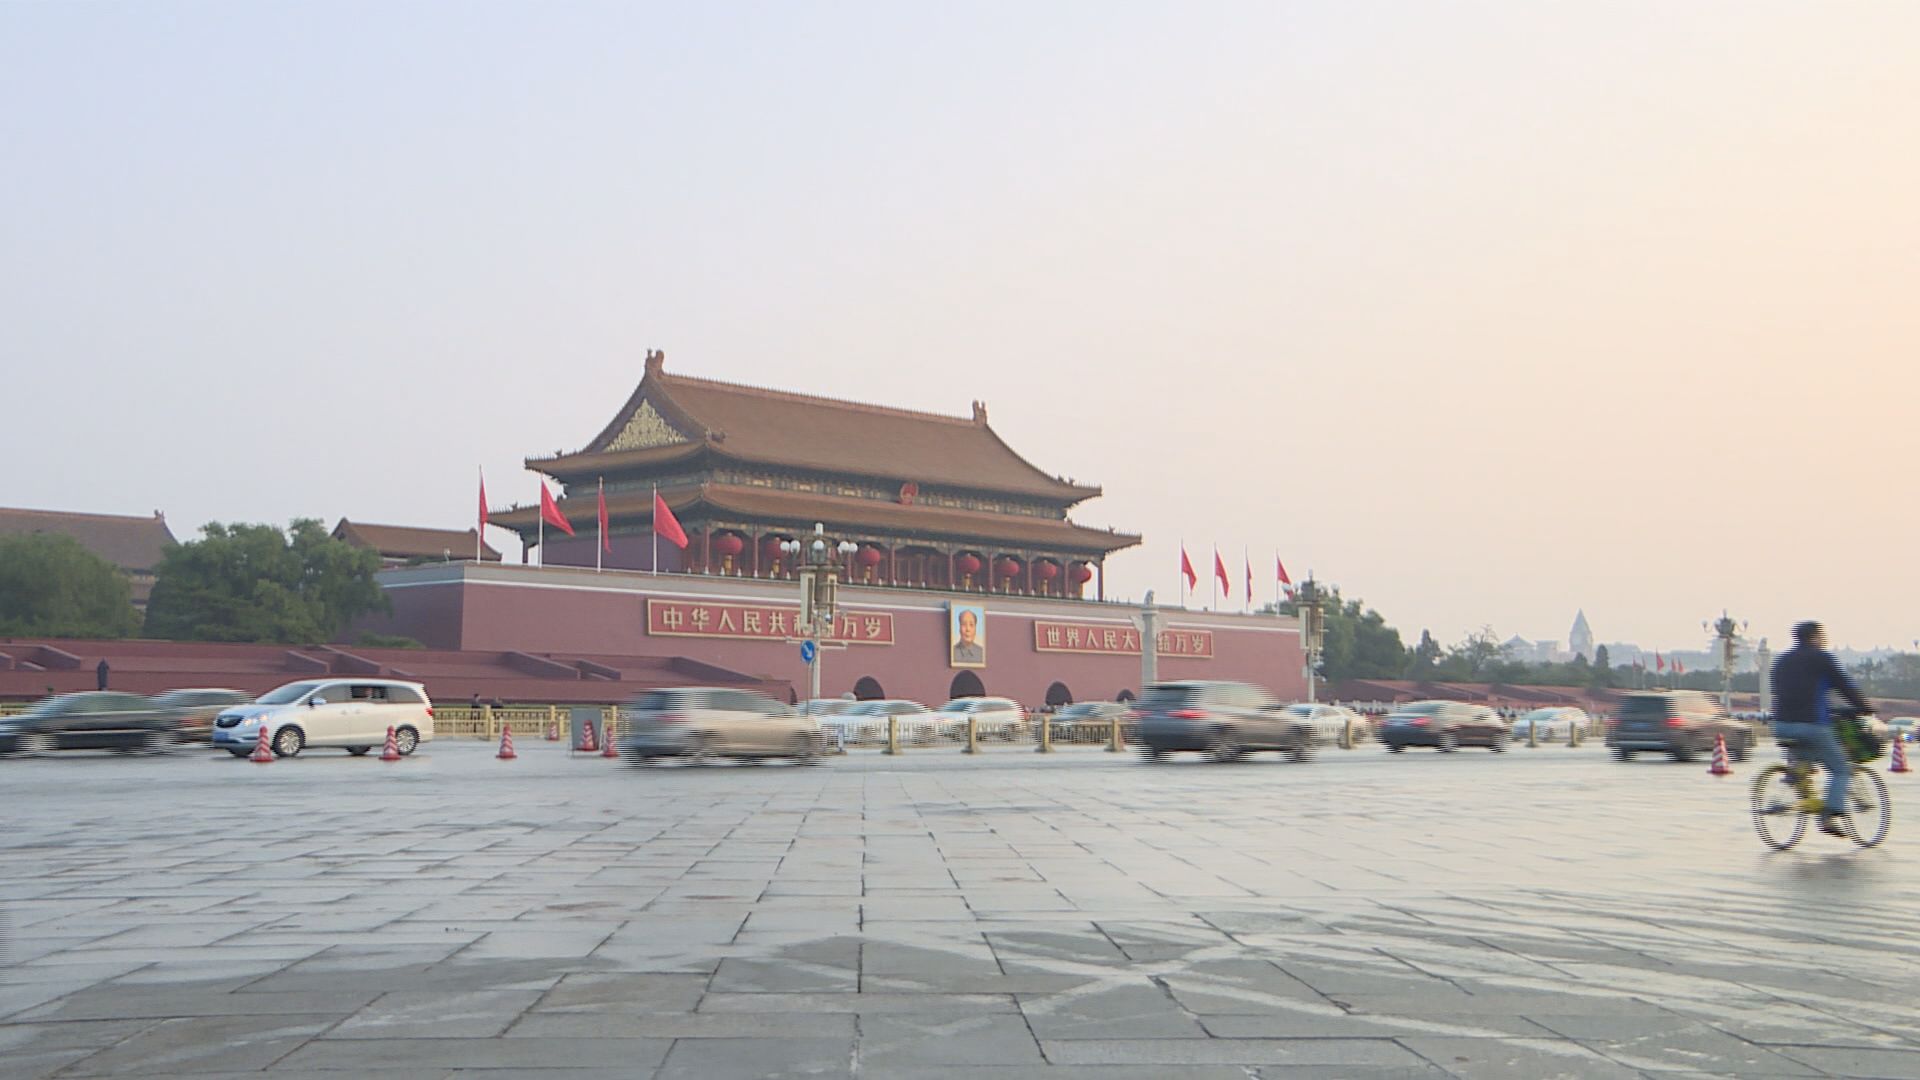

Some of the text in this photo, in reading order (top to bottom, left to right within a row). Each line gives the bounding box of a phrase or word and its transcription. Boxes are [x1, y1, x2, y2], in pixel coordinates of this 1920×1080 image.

[1046, 627, 1204, 653] 世界人民大结万岁
